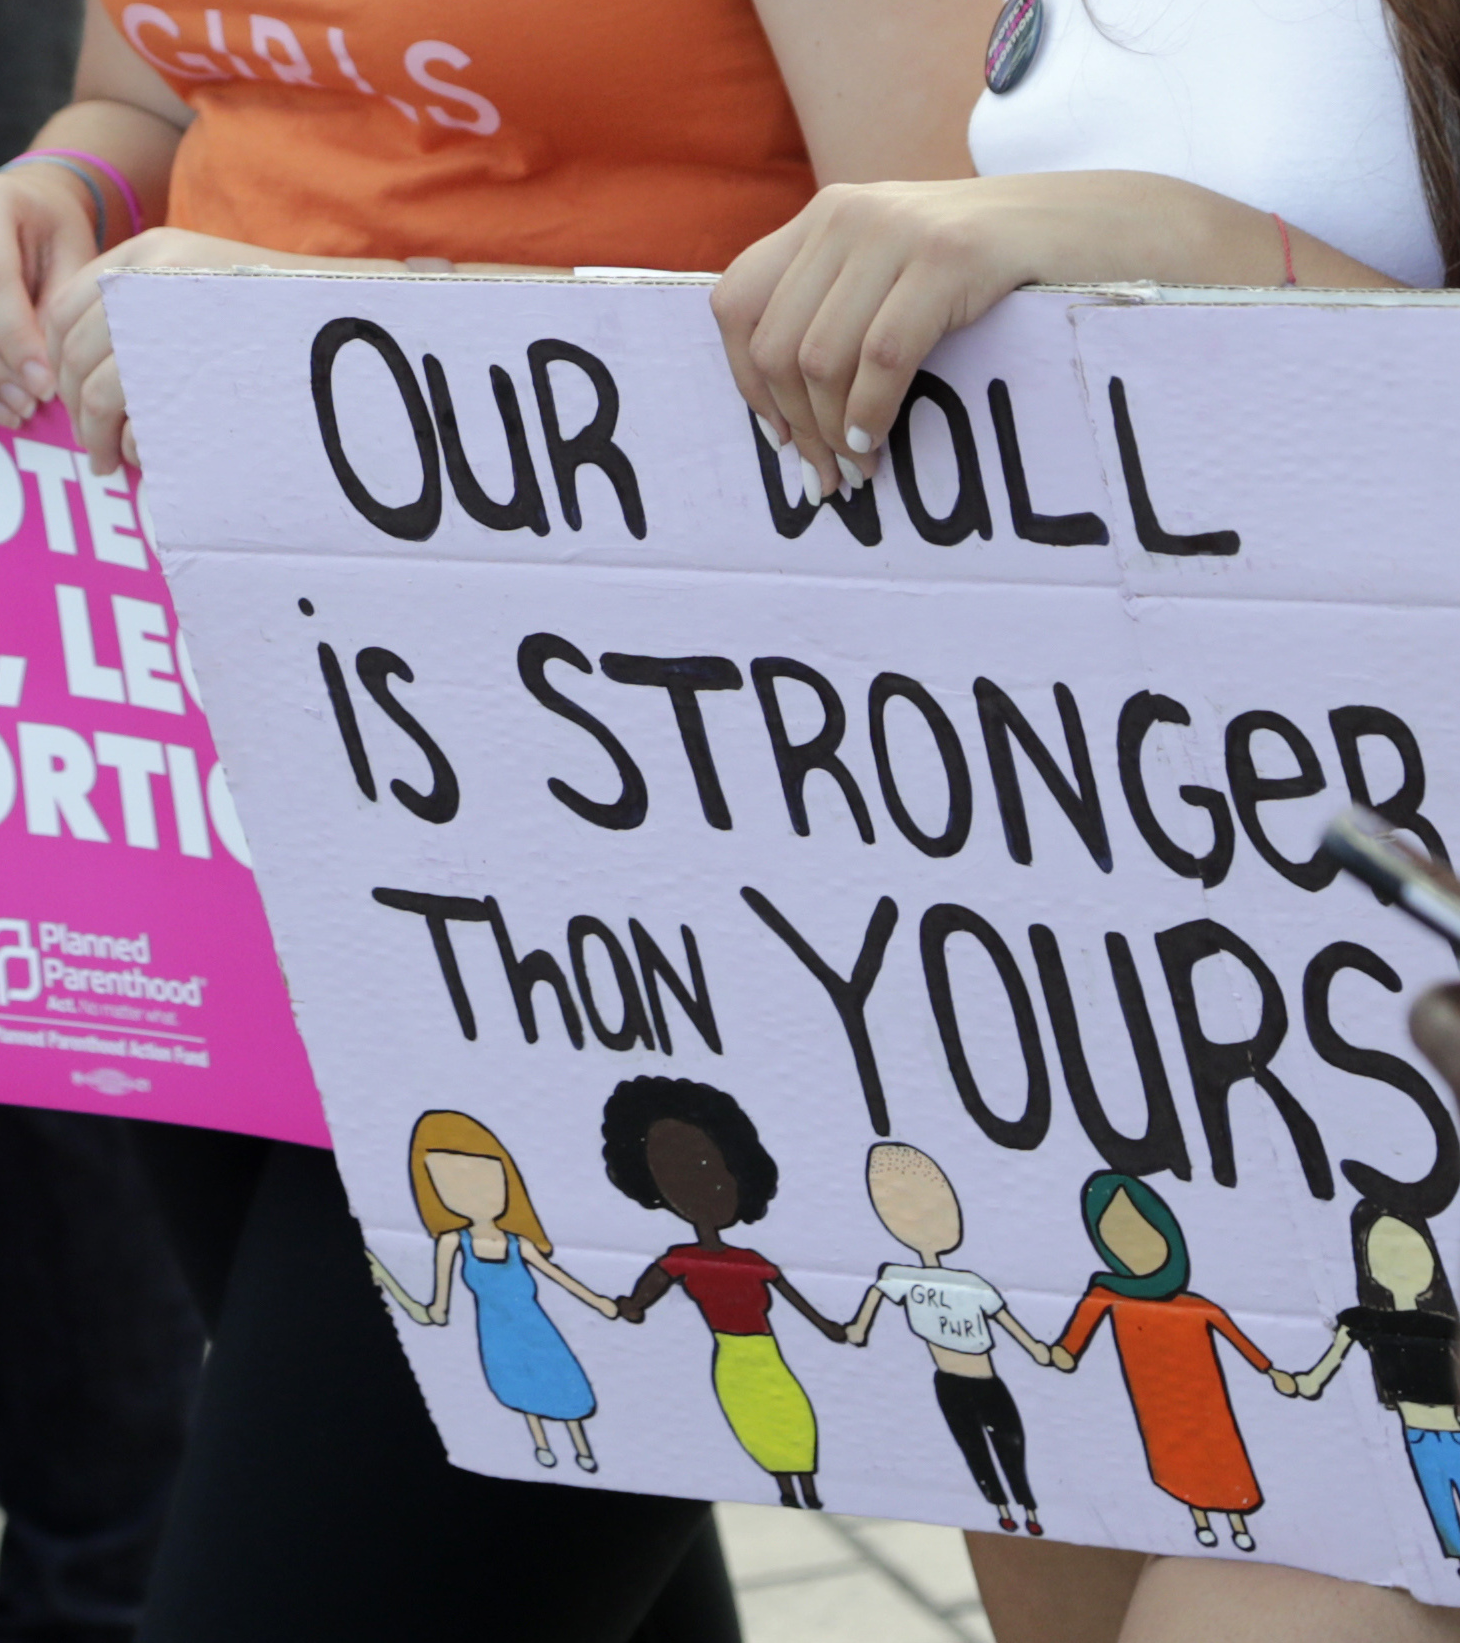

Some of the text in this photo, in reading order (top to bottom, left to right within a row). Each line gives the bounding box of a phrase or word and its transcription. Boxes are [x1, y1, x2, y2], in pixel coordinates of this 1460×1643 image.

[121, 3, 502, 136] GIRLS
[39, 920, 152, 965] Planned
[43, 958, 207, 1008] Parenthood
[910, 1283, 953, 1310] GRL
[938, 1312, 984, 1347] PWR!
